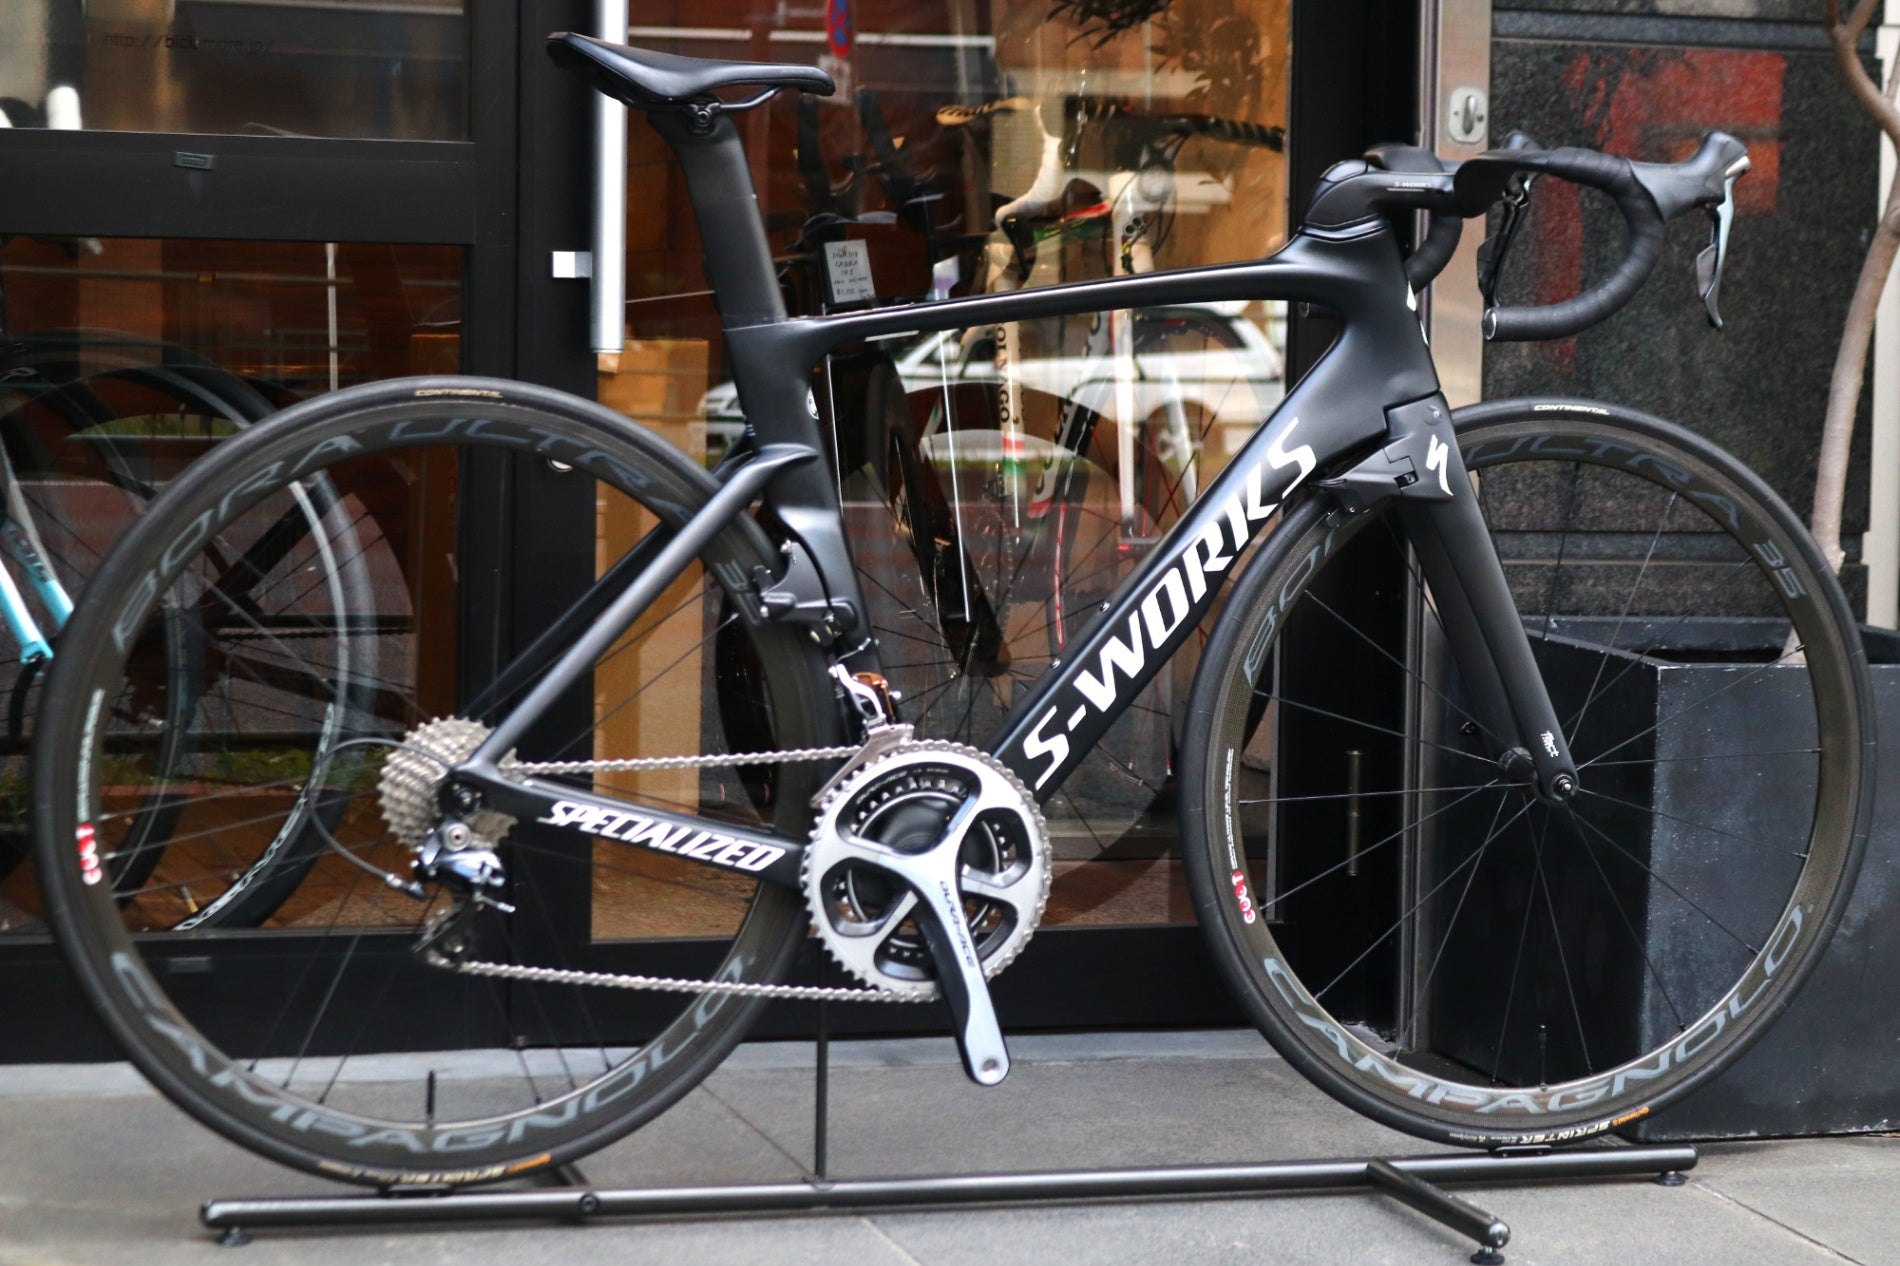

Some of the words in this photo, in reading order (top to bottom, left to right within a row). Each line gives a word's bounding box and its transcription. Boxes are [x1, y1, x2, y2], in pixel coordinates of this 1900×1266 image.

[1534, 404, 1610, 416] CONTINENTAL
[113, 434, 363, 651] BORA
[1022, 417, 1317, 789] S-WORKS
[1465, 434, 1740, 530] ULTRA
[1753, 538, 1809, 600] 35
[536, 800, 786, 872] SPECIALIZED
[110, 951, 744, 1155] CAMPAGNOLO
[1262, 902, 1805, 1115] CAMPAGNOLO
[1519, 1120, 1611, 1144] SPRINTER
